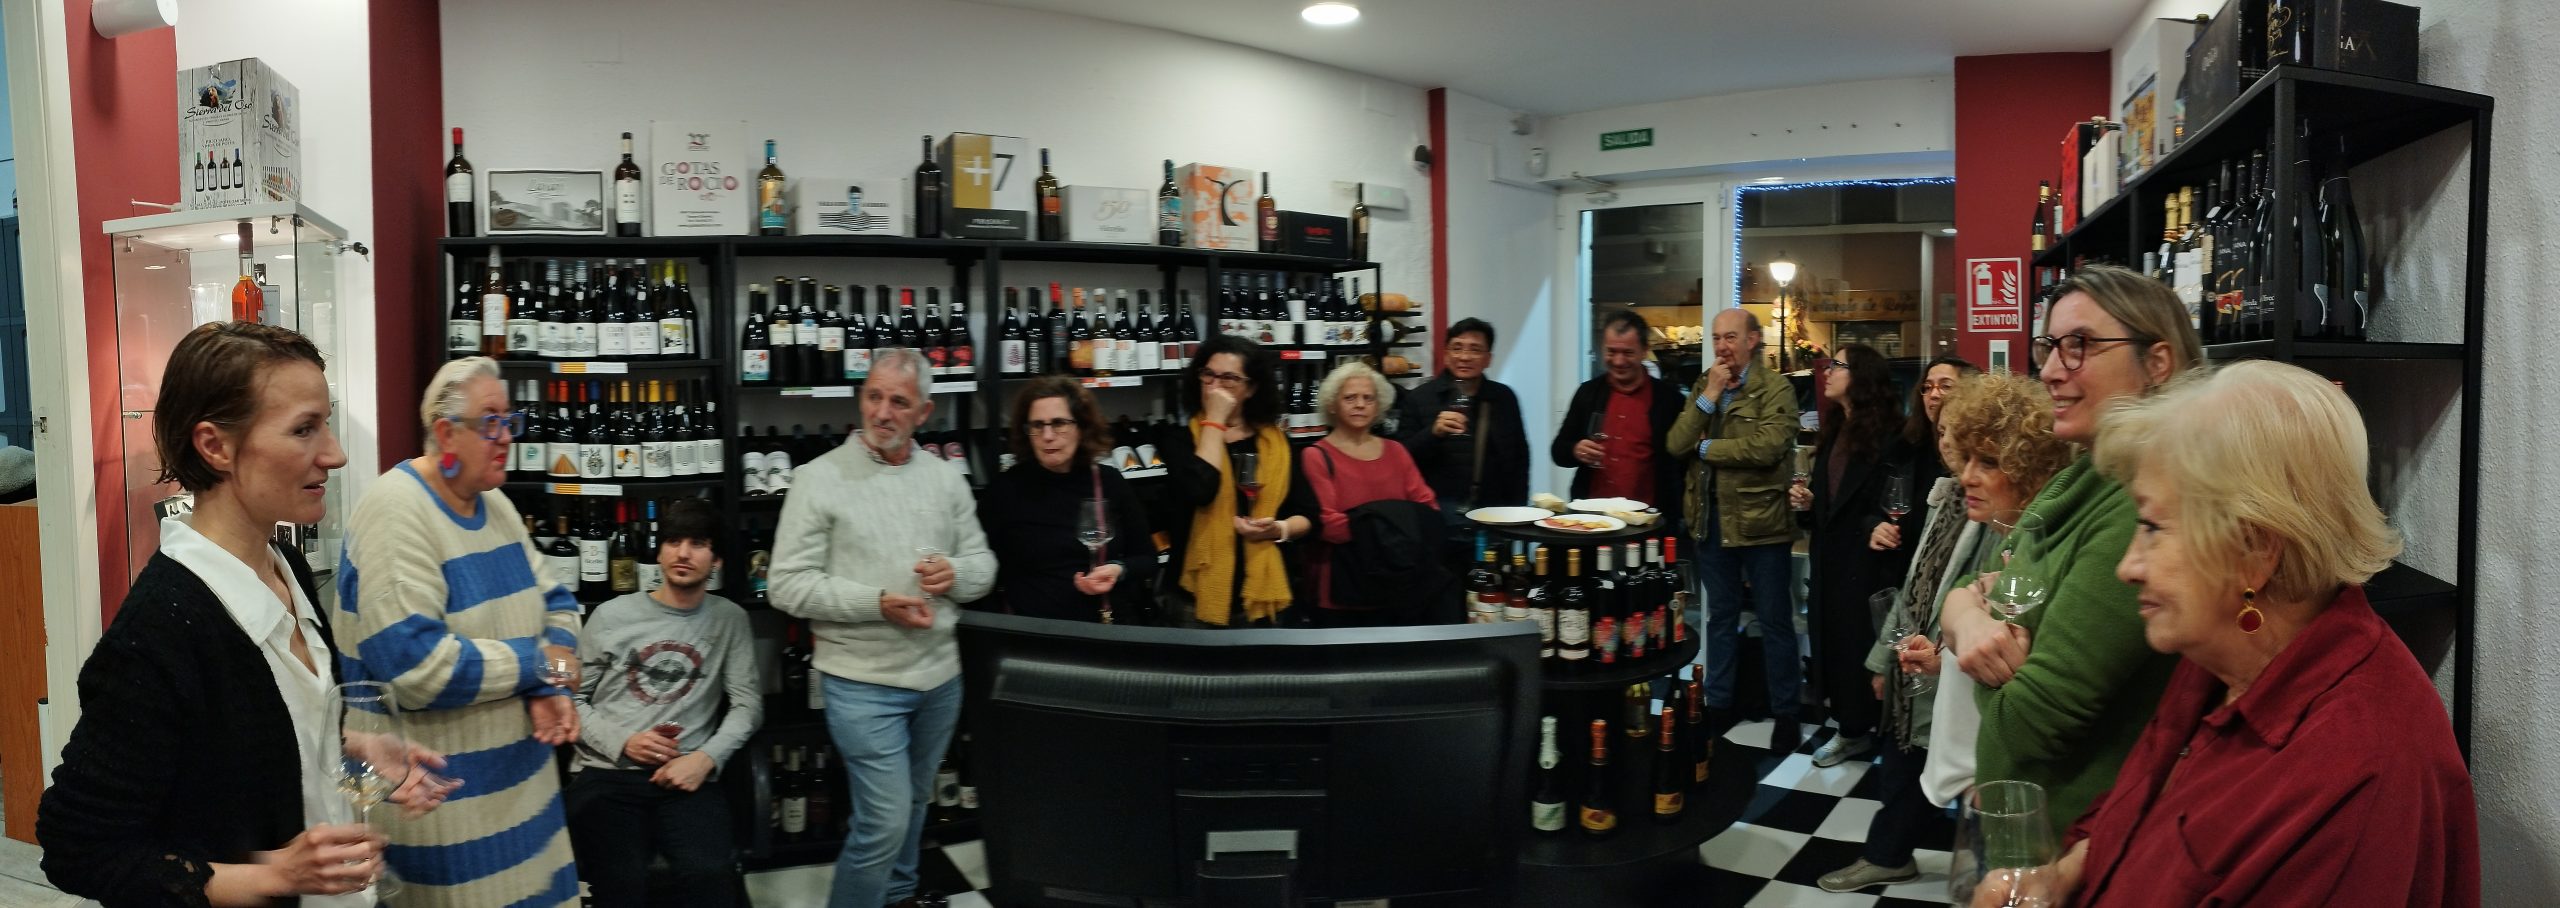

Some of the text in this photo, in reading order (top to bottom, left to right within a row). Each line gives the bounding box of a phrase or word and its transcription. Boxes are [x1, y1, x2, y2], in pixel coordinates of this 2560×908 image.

[184, 106, 217, 120] Sierra
[219, 103, 233, 113] del
[234, 100, 253, 110] Oso
[1603, 131, 1650, 147] SALIDA
[660, 161, 720, 175] GOTAS
[677, 176, 738, 191] ROCIO
[1973, 314, 2018, 326] EXTINTOR
